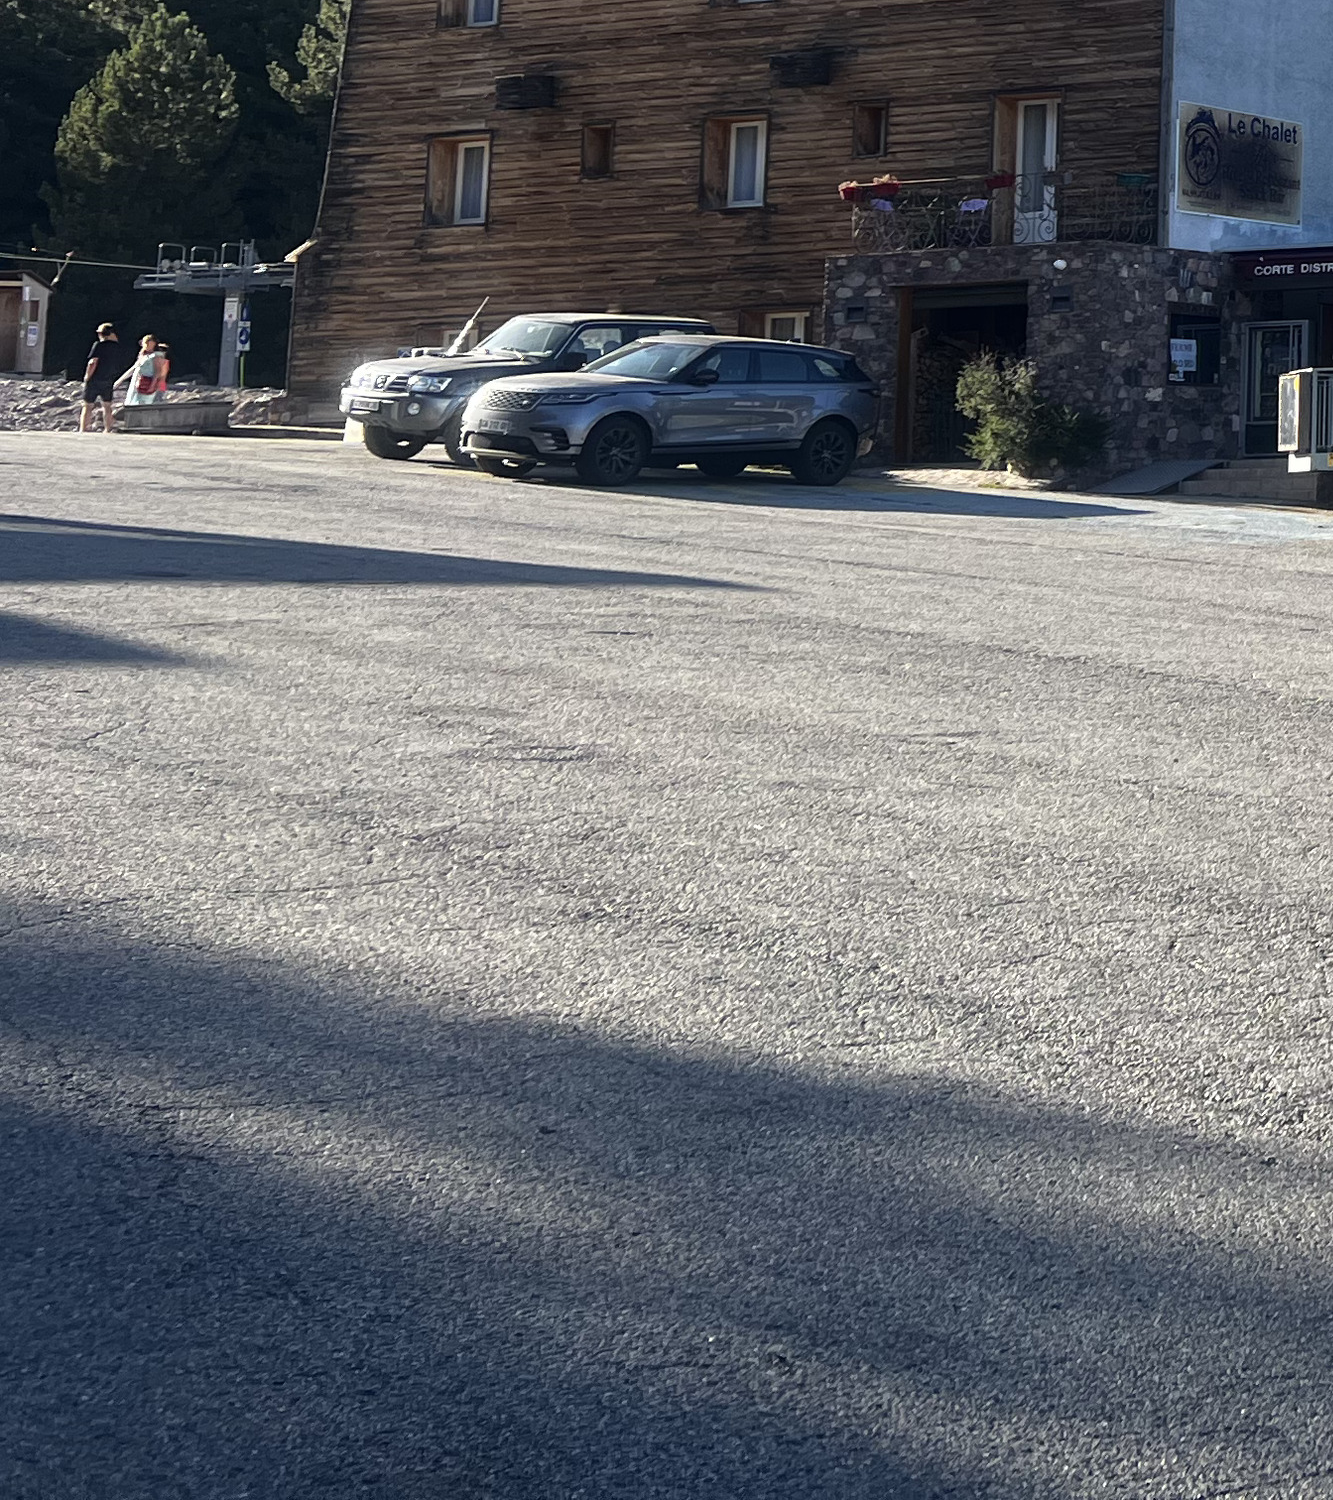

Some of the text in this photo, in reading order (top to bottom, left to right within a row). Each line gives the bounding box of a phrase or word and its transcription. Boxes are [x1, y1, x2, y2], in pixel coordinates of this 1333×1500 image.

[1227, 112, 1298, 145] Le Chalet
[1253, 263, 1295, 276] CORTE
